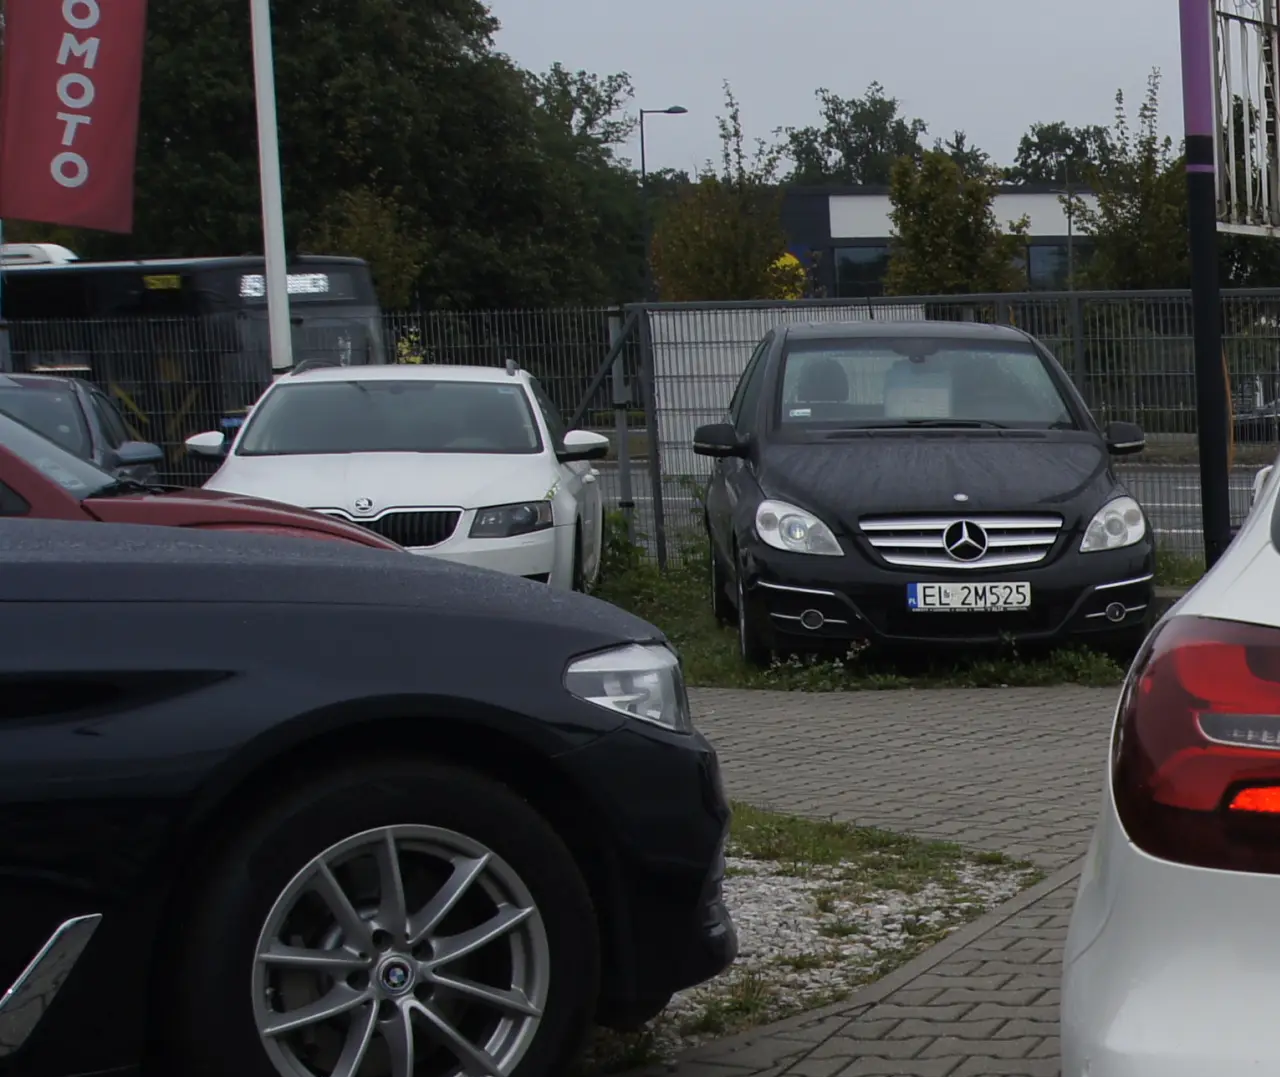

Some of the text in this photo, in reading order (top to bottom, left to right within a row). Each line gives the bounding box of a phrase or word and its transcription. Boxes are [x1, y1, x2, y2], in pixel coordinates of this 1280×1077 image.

[50, 0, 100, 188] OMOTO
[922, 584, 1027, 606] EL 2M525
